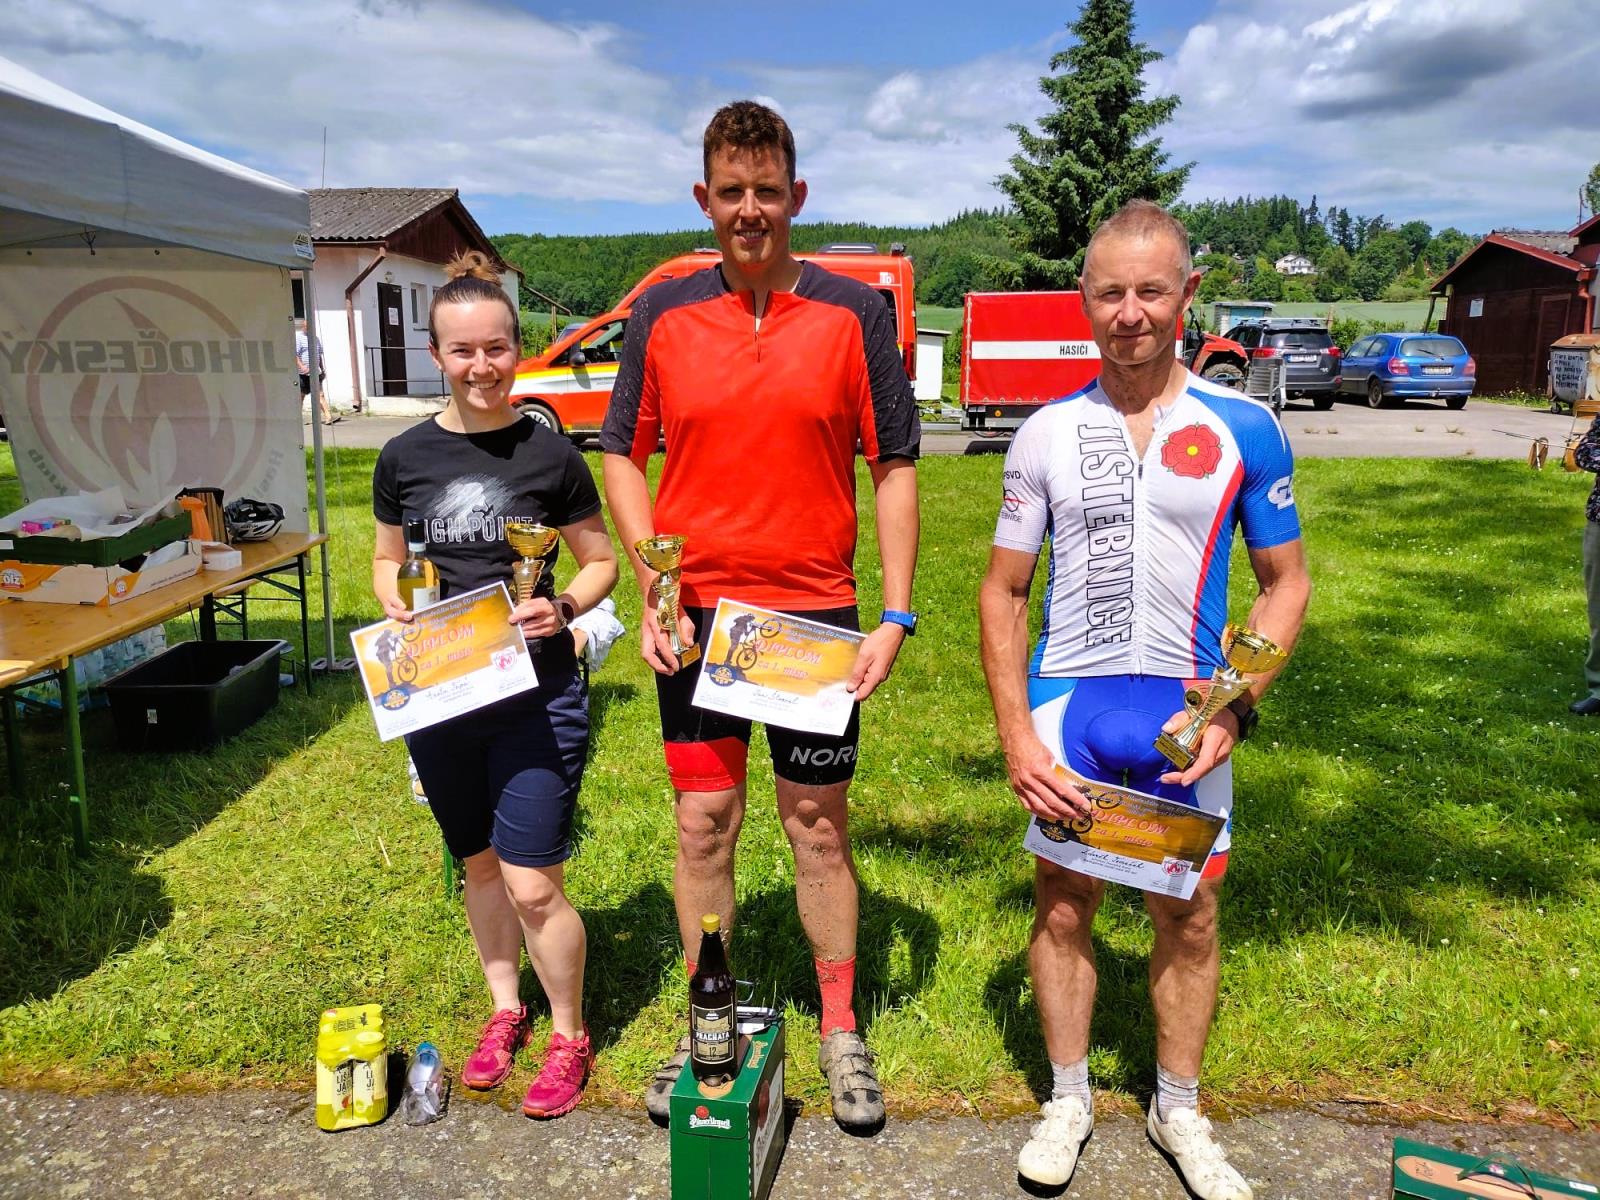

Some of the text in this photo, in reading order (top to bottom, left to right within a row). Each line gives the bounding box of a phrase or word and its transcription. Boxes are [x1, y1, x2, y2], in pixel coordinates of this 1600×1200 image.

[1059, 343, 1088, 356] HASIČI
[424, 518, 462, 545] IGH
[1076, 423, 1136, 648] JISTEBNICE
